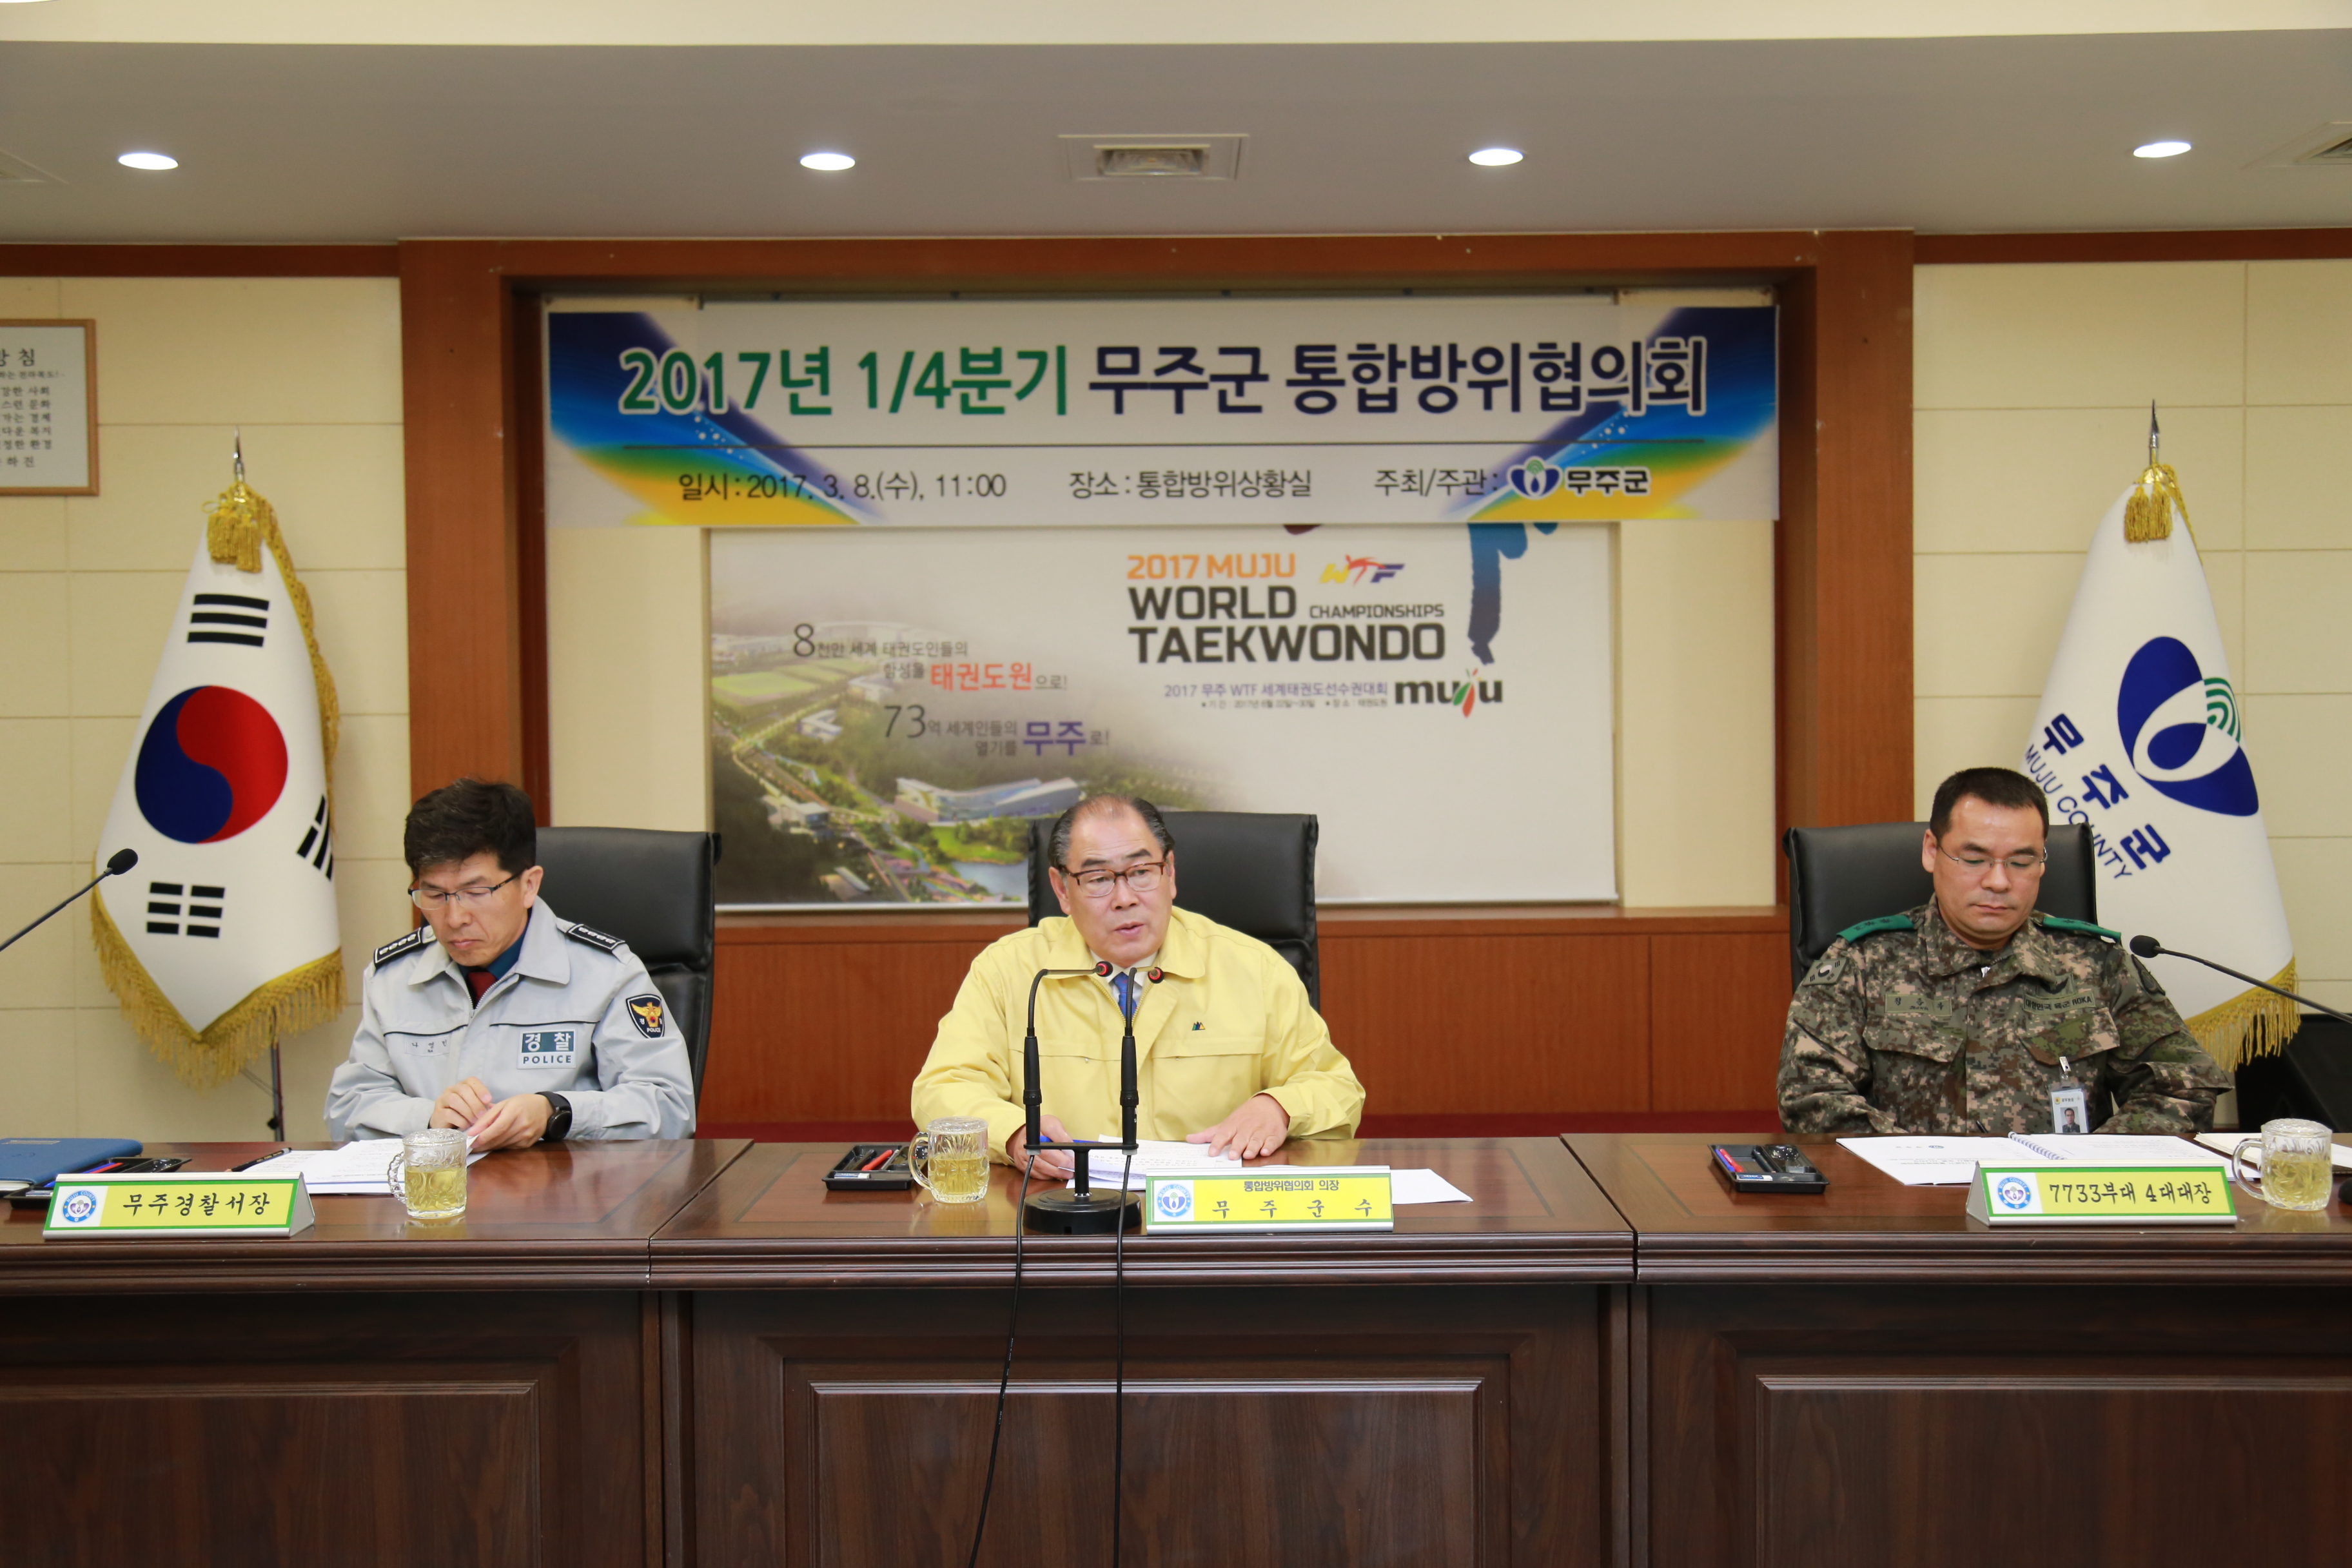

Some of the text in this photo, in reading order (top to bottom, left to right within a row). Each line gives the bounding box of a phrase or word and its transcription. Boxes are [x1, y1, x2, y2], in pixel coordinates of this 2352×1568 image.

[620, 337, 1706, 416] 2017년 1/4분기 무주군 통합방위협의회
[823, 474, 845, 501] 3.
[936, 471, 1006, 499] 11:00
[1565, 468, 1651, 496] 무주군
[1126, 553, 1297, 580] 2017 MUJU
[1128, 585, 1297, 620] WORLD
[1309, 603, 1445, 620] CHAMPIONSHIPS
[851, 640, 877, 657] 세계
[882, 640, 968, 658] 태권도인들의
[1128, 623, 1446, 664] TAEKWONDO
[1164, 681, 1388, 698] 2017 무주 WTF 세계태권도선수권대회
[945, 720, 1018, 737] 세계인들의
[2043, 712, 2171, 870] 무주군
[2024, 743, 2133, 879] MUJU CONTY
[2024, 999, 2052, 1011] 대한민국
[2072, 995, 2092, 1006] ROKA
[524, 1032, 572, 1052] 경찰
[522, 1055, 572, 1064] POLICE
[1243, 1179, 1340, 1191] 통합방위협의회 의장
[2049, 1182, 2136, 1204] 7733부대
[2144, 1181, 2212, 1204] 4대대장
[122, 1191, 271, 1217] 무주경찰서장
